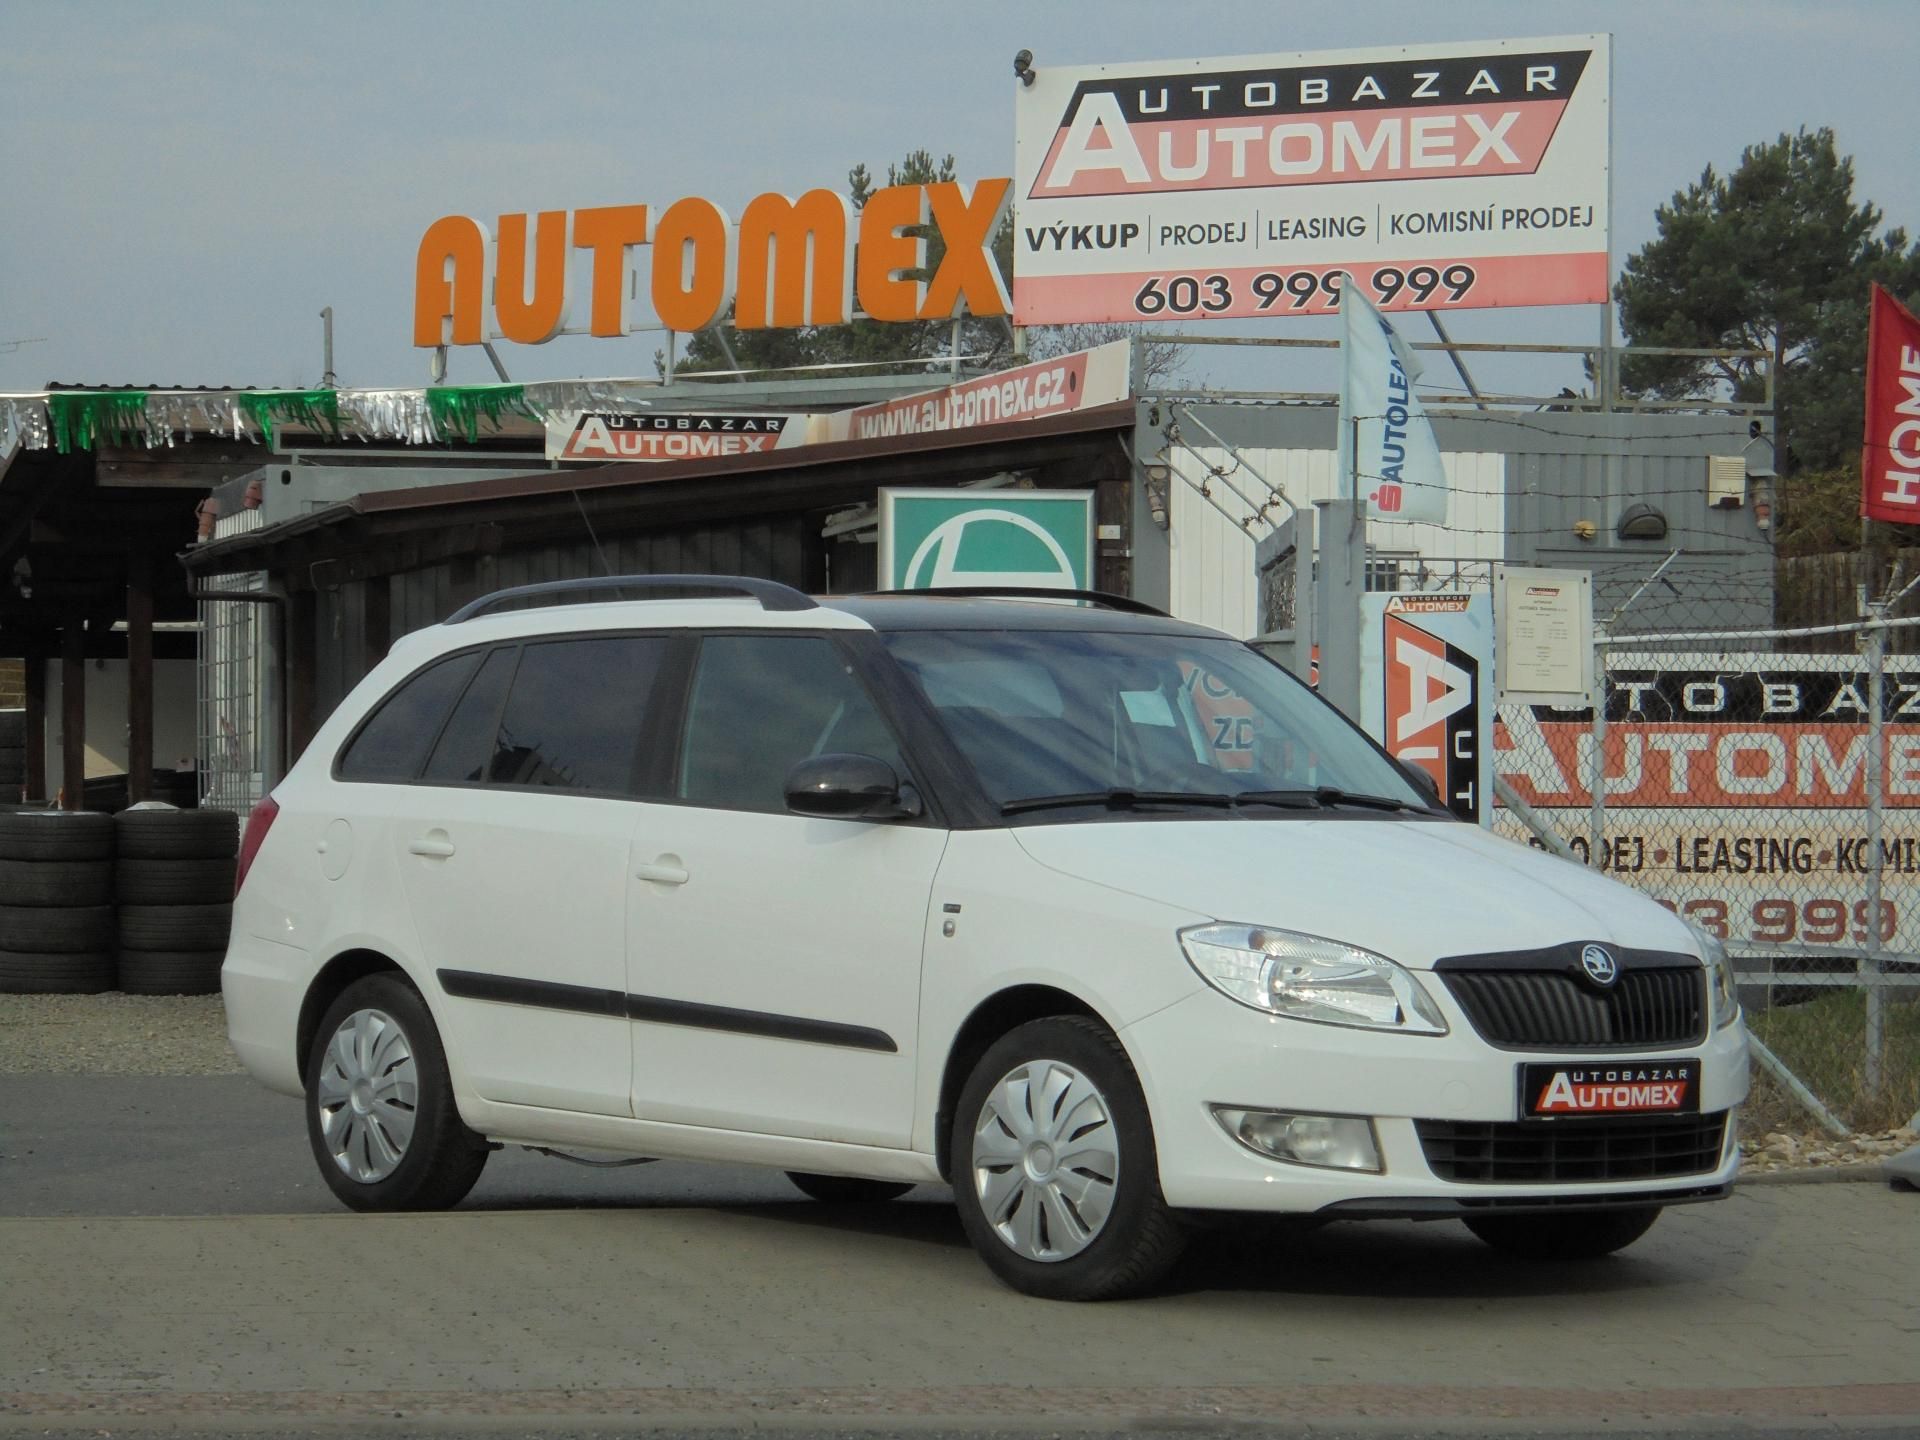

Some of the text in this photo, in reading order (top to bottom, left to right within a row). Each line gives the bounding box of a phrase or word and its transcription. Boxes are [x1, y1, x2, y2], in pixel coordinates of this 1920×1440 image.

[1044, 91, 1522, 188] AUTOMEX
[1025, 220, 1139, 252] VÝKUP
[1160, 222, 1247, 246] PRODEJ
[1267, 215, 1367, 242] LEASING
[1390, 203, 1594, 235] KOMISNÍ PRODEJ
[413, 177, 1013, 348] AUTOMEX
[1134, 264, 1476, 315] 603 999 999
[860, 367, 1065, 439] www.automex.cz
[571, 417, 766, 455] AUTOMEX
[1386, 597, 1465, 613] AUTOMEX
[1676, 837, 1812, 874] LEASING
[1751, 899, 1896, 943] 999
[1542, 1072, 1678, 1108] AUTOMEX
